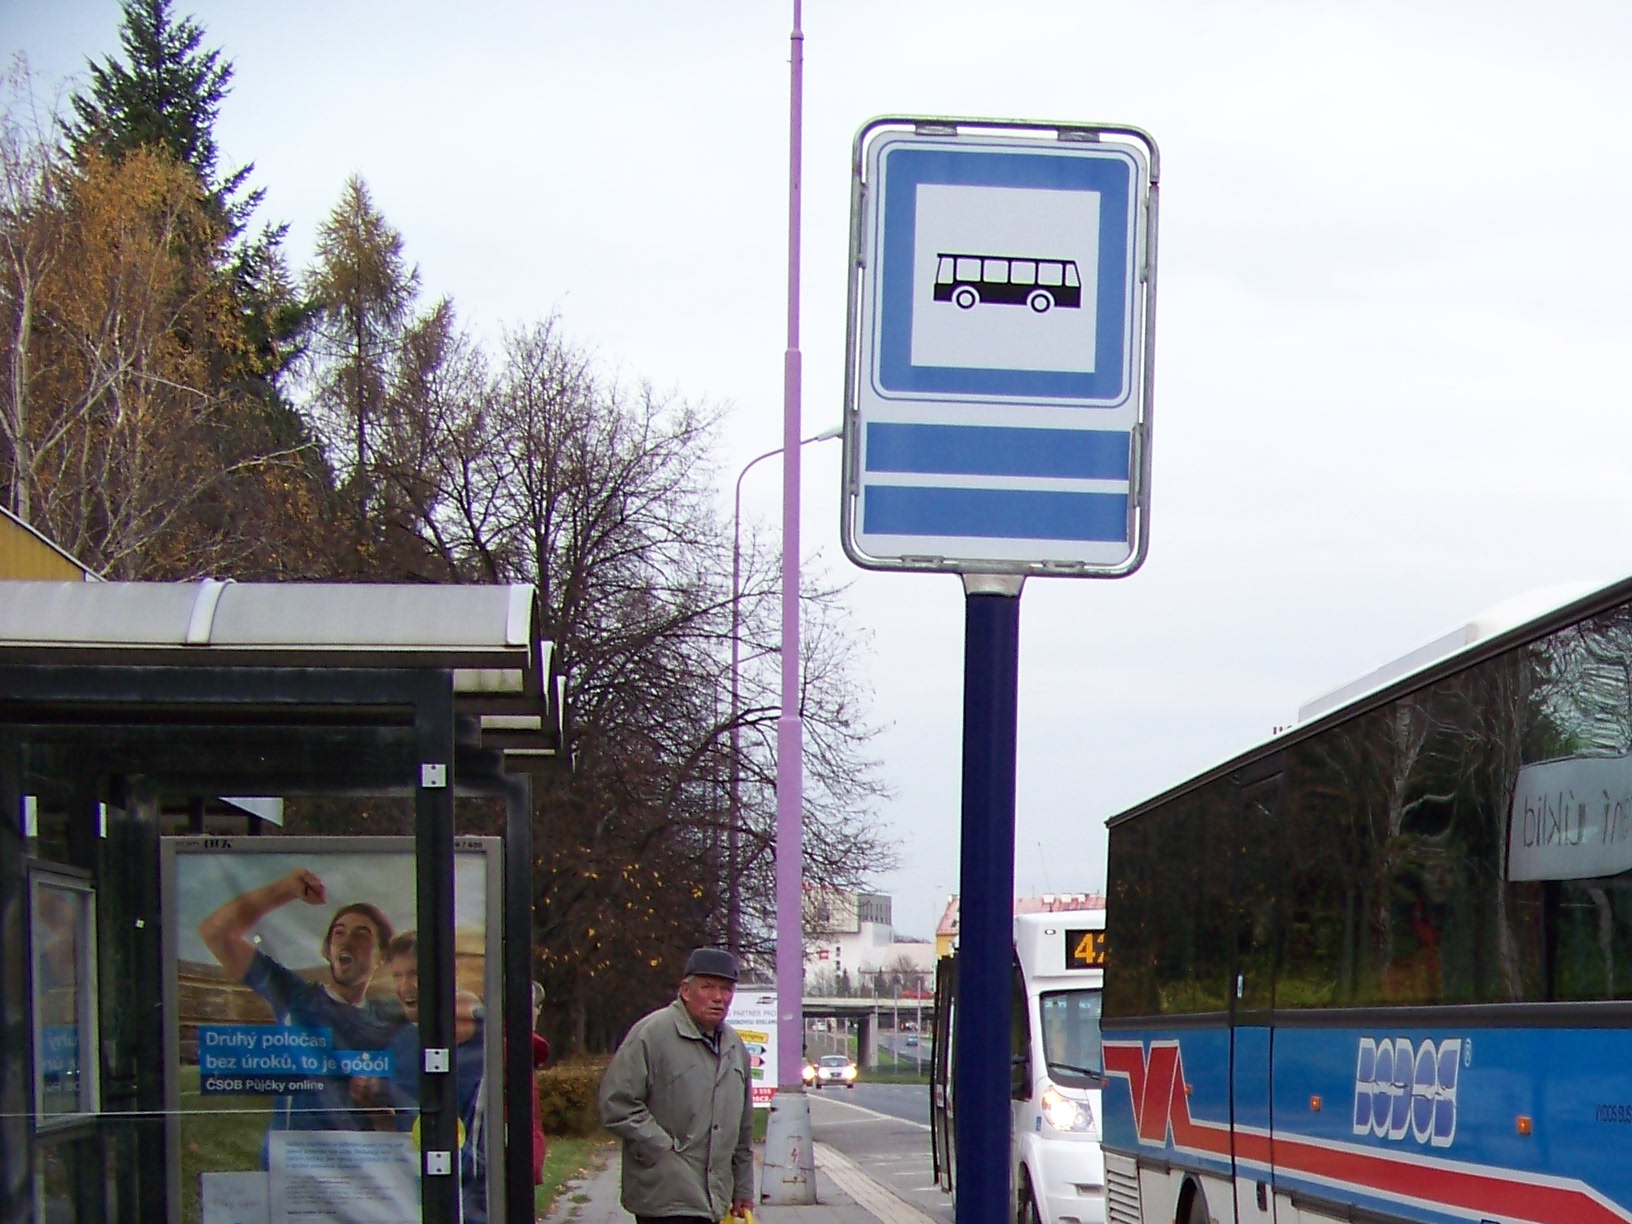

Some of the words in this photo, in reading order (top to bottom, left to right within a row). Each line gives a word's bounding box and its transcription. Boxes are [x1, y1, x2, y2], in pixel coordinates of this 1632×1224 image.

[205, 1031, 257, 1049] Druhý
[262, 1031, 327, 1049] poločas
[206, 1055, 237, 1069] bez
[242, 1053, 296, 1070] úroků,
[302, 1056, 318, 1069] to
[322, 1055, 337, 1072] je
[206, 1076, 243, 1090] ČSOB
[246, 1077, 286, 1093] Půjčky
[288, 1079, 325, 1091] online
